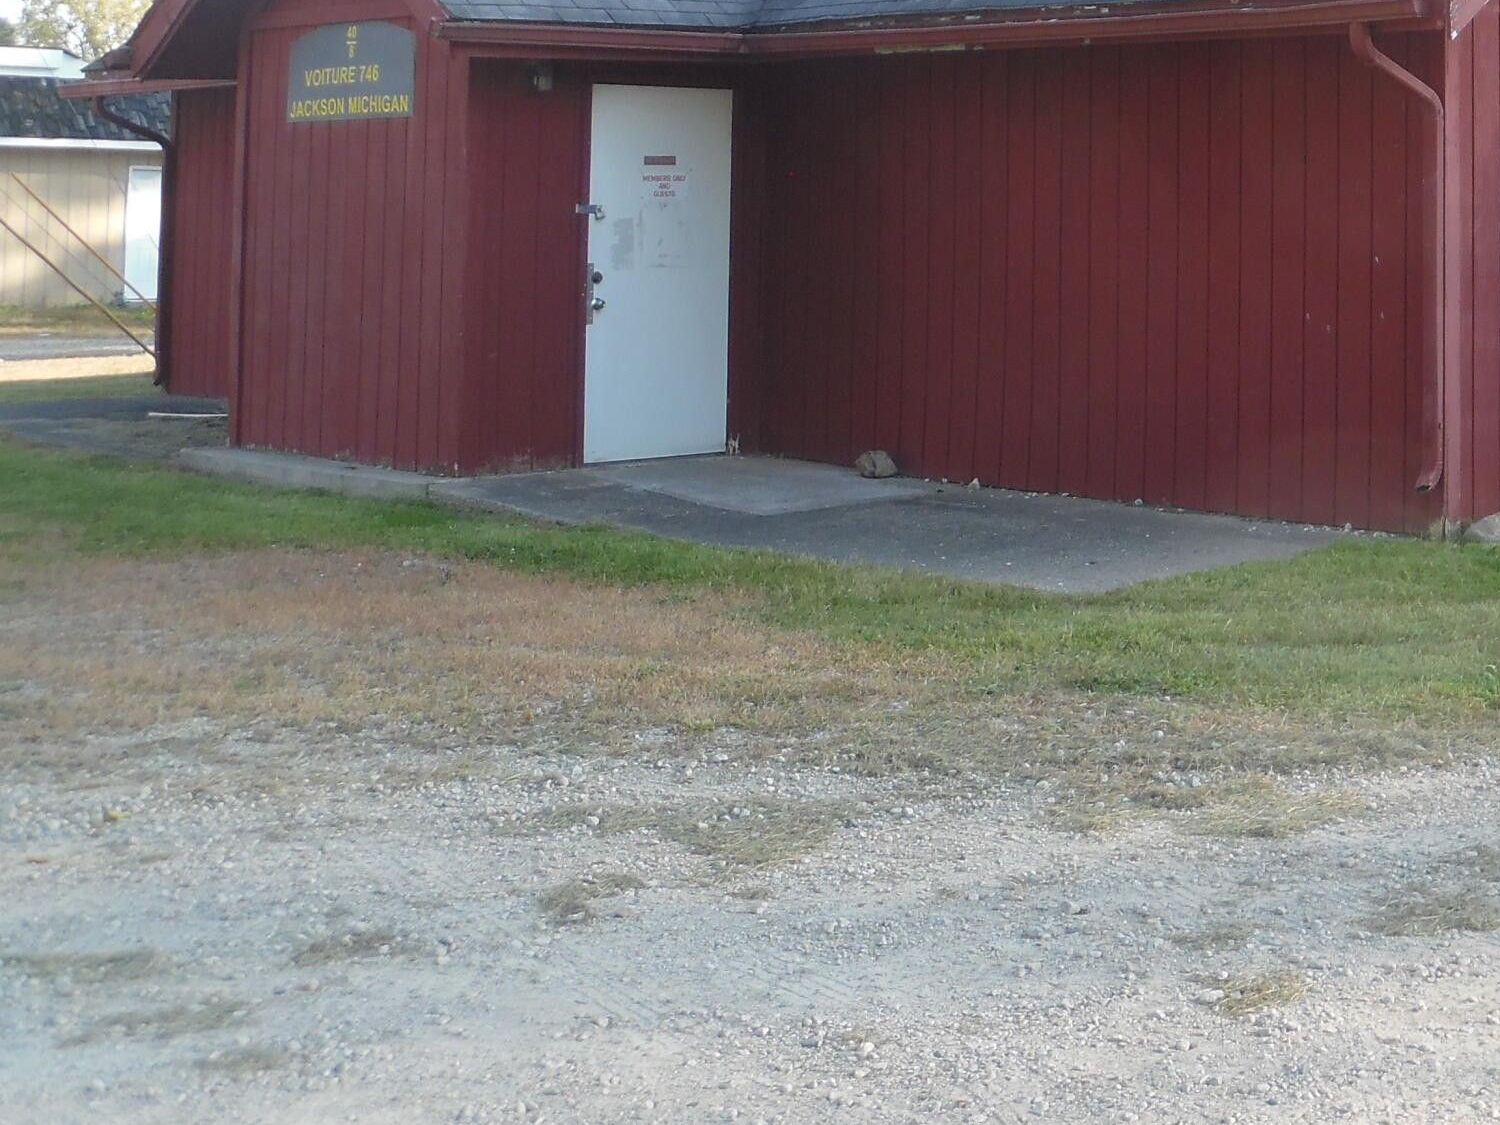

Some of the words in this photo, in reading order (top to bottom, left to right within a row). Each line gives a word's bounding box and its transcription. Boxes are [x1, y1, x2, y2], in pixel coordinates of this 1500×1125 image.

[346, 25, 357, 39] 40
[304, 66, 356, 87] VOITURE
[359, 64, 380, 83] 746
[290, 97, 344, 118] JACKSON
[348, 94, 409, 113] MICHIGAN
[642, 174, 671, 182] MEMBERS
